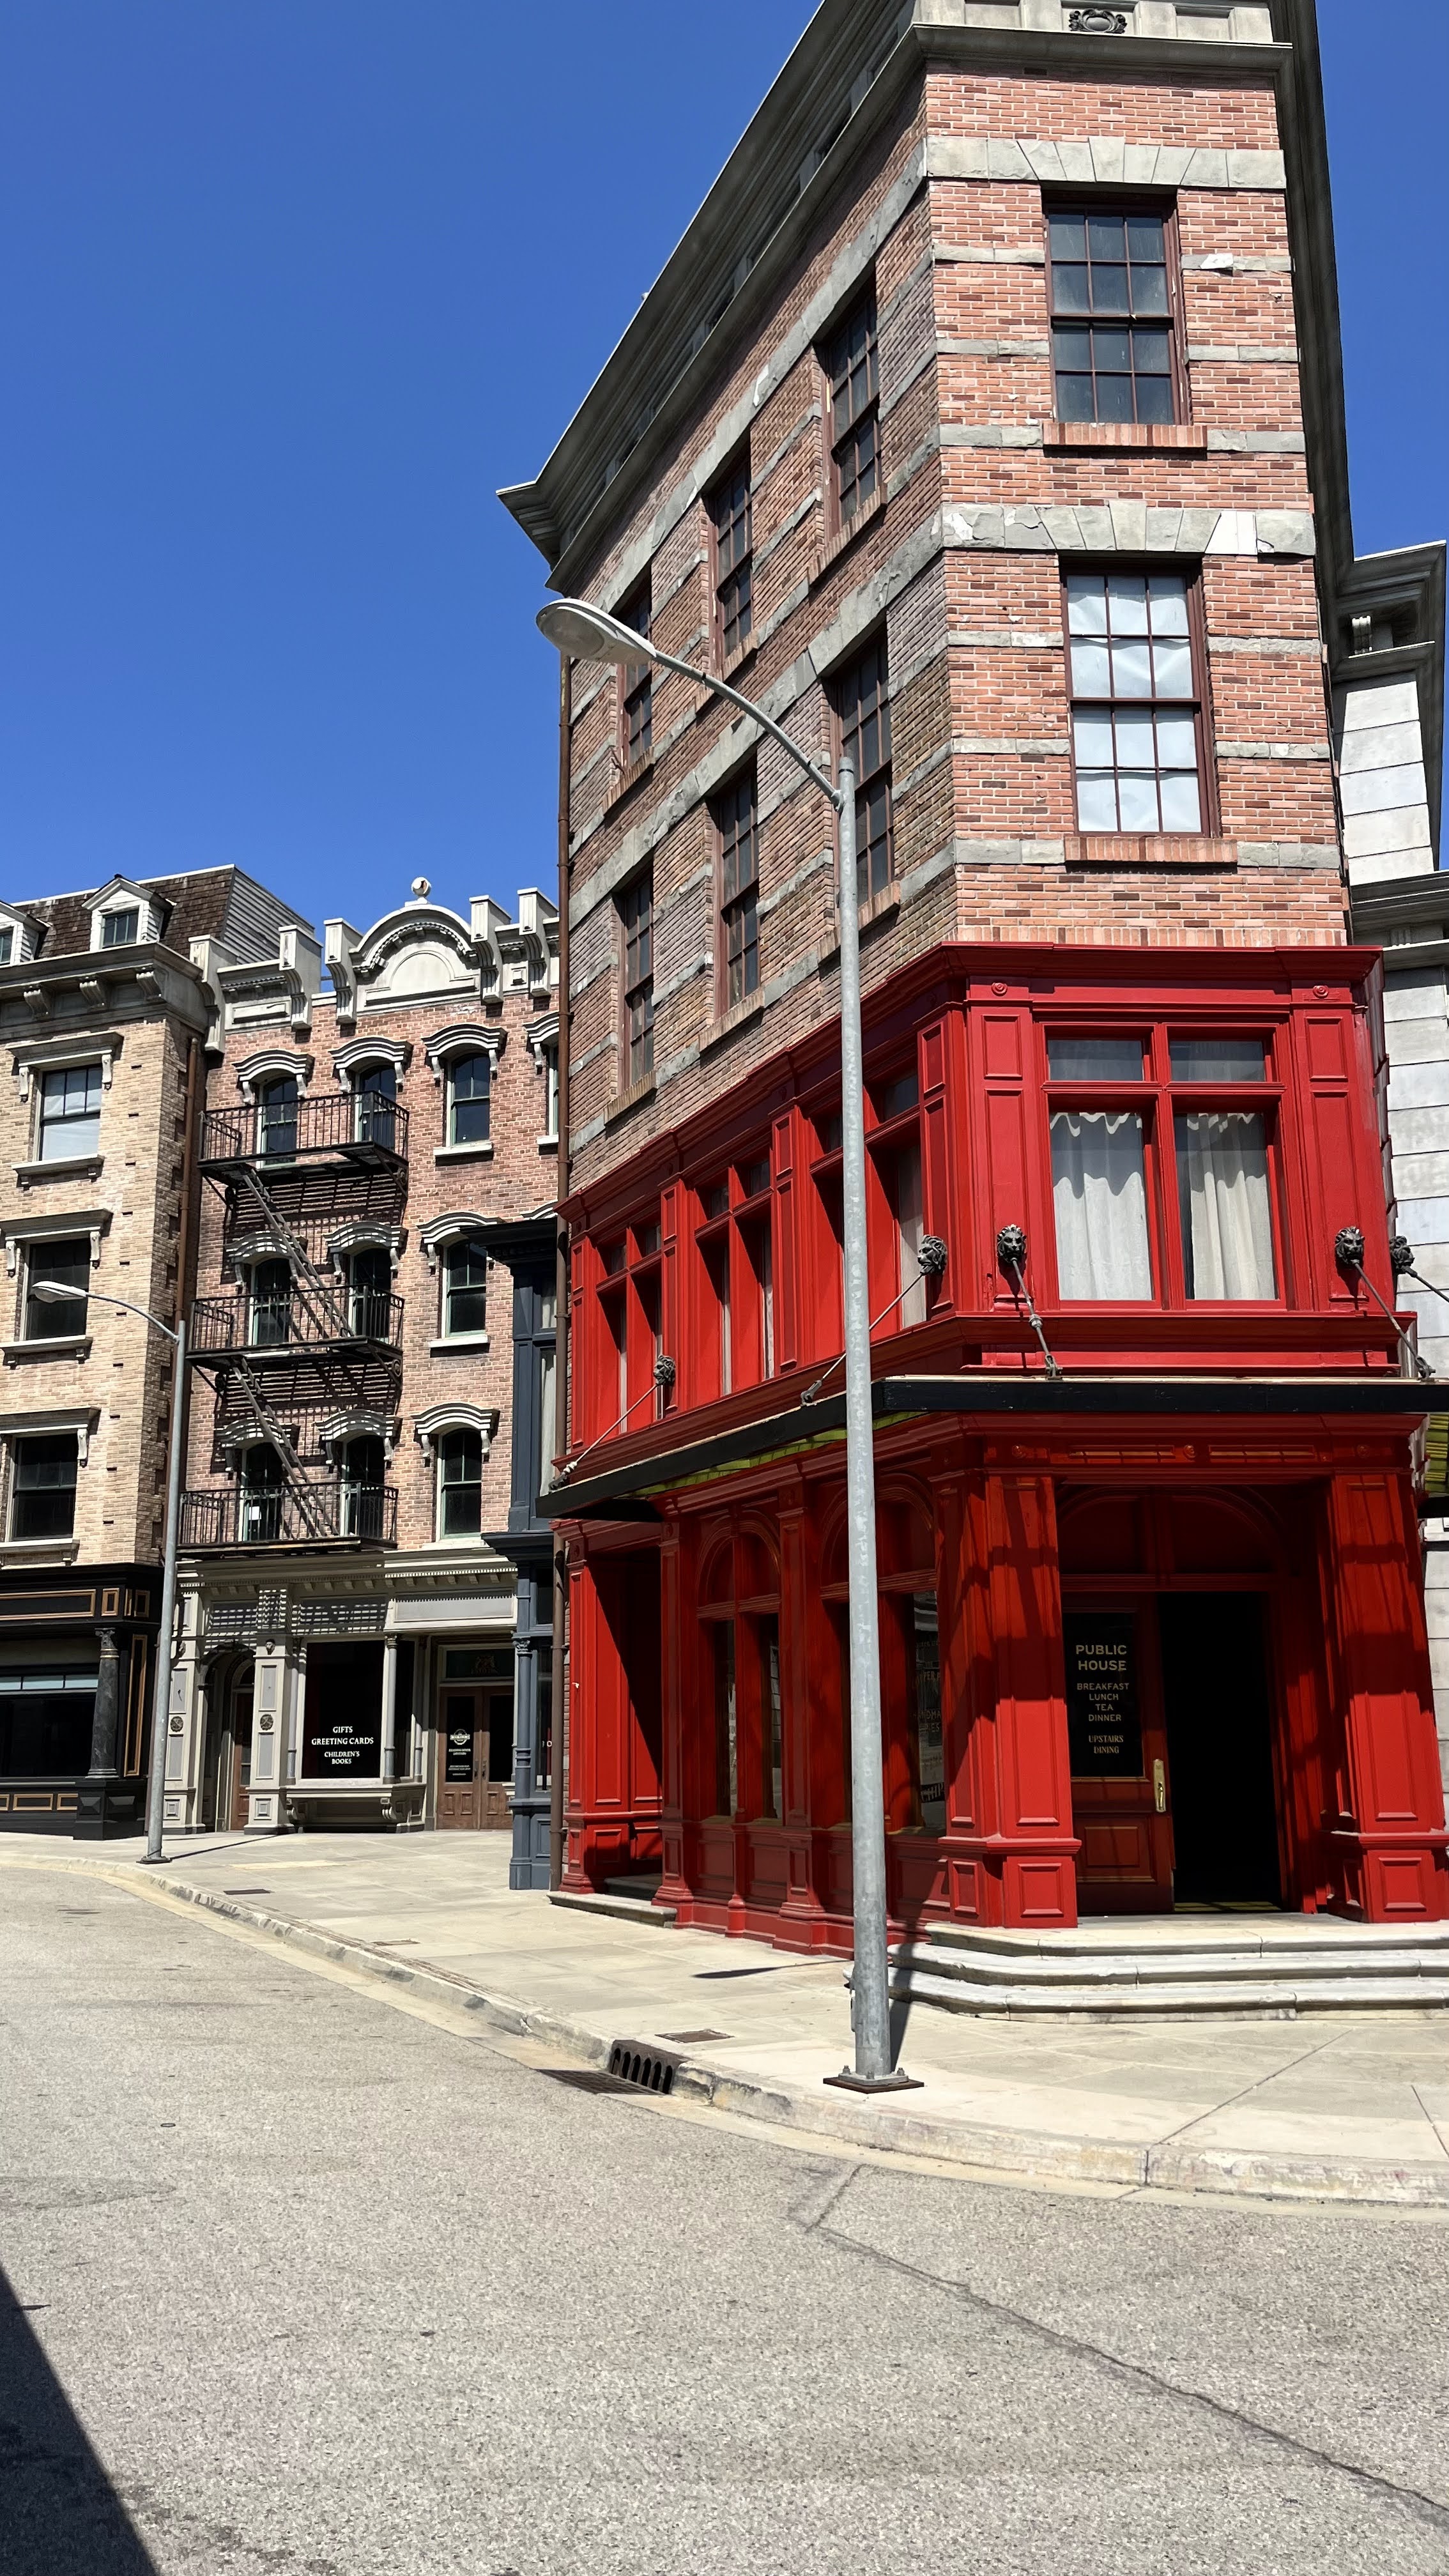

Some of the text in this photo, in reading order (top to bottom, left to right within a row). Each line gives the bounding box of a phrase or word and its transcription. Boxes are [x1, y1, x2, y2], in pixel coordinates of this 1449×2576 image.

[1075, 1644, 1127, 1655] PUBLIC
[1078, 1660, 1127, 1671] HOUSE
[1089, 1735, 1124, 1743] UPSTAIRS
[1093, 1745, 1119, 1754] DINING
